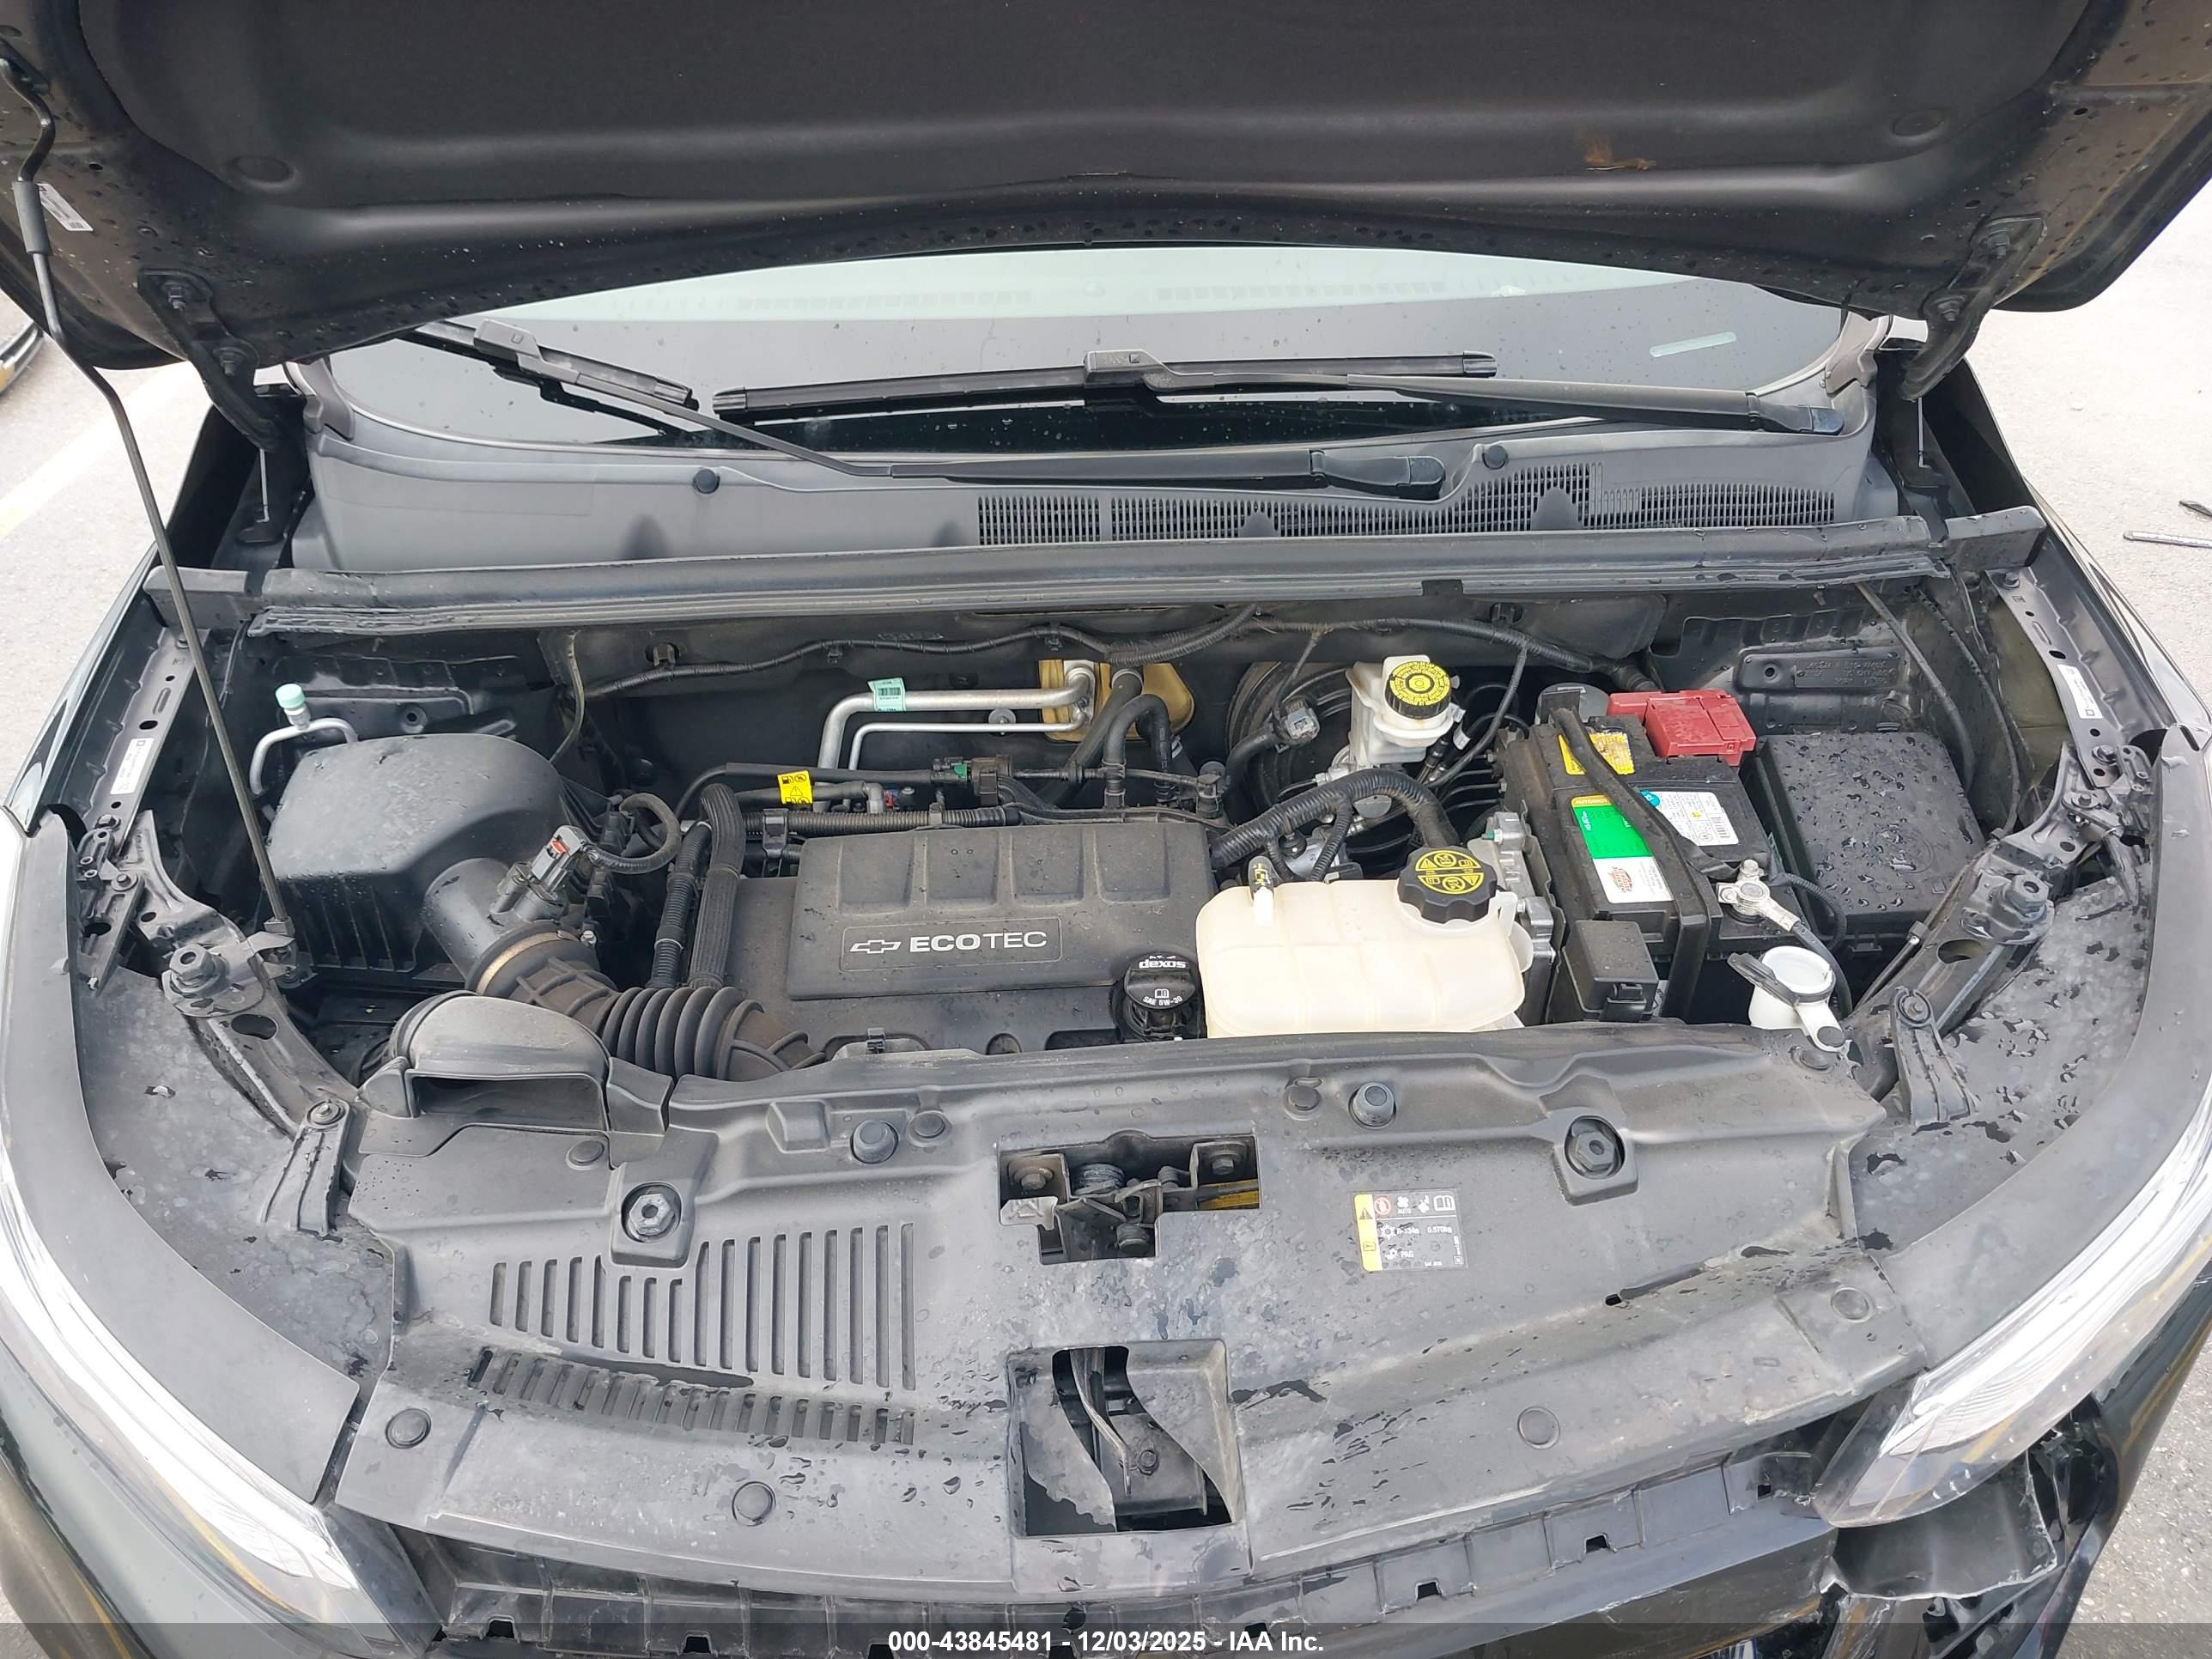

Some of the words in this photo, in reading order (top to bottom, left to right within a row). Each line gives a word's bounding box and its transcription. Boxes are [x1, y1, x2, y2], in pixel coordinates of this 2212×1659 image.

[910, 931, 1047, 952] ECOTEC
[1139, 958, 1187, 969] dexos
[1143, 996, 1158, 1006] SAE
[1158, 995, 1183, 1006] 5W-30
